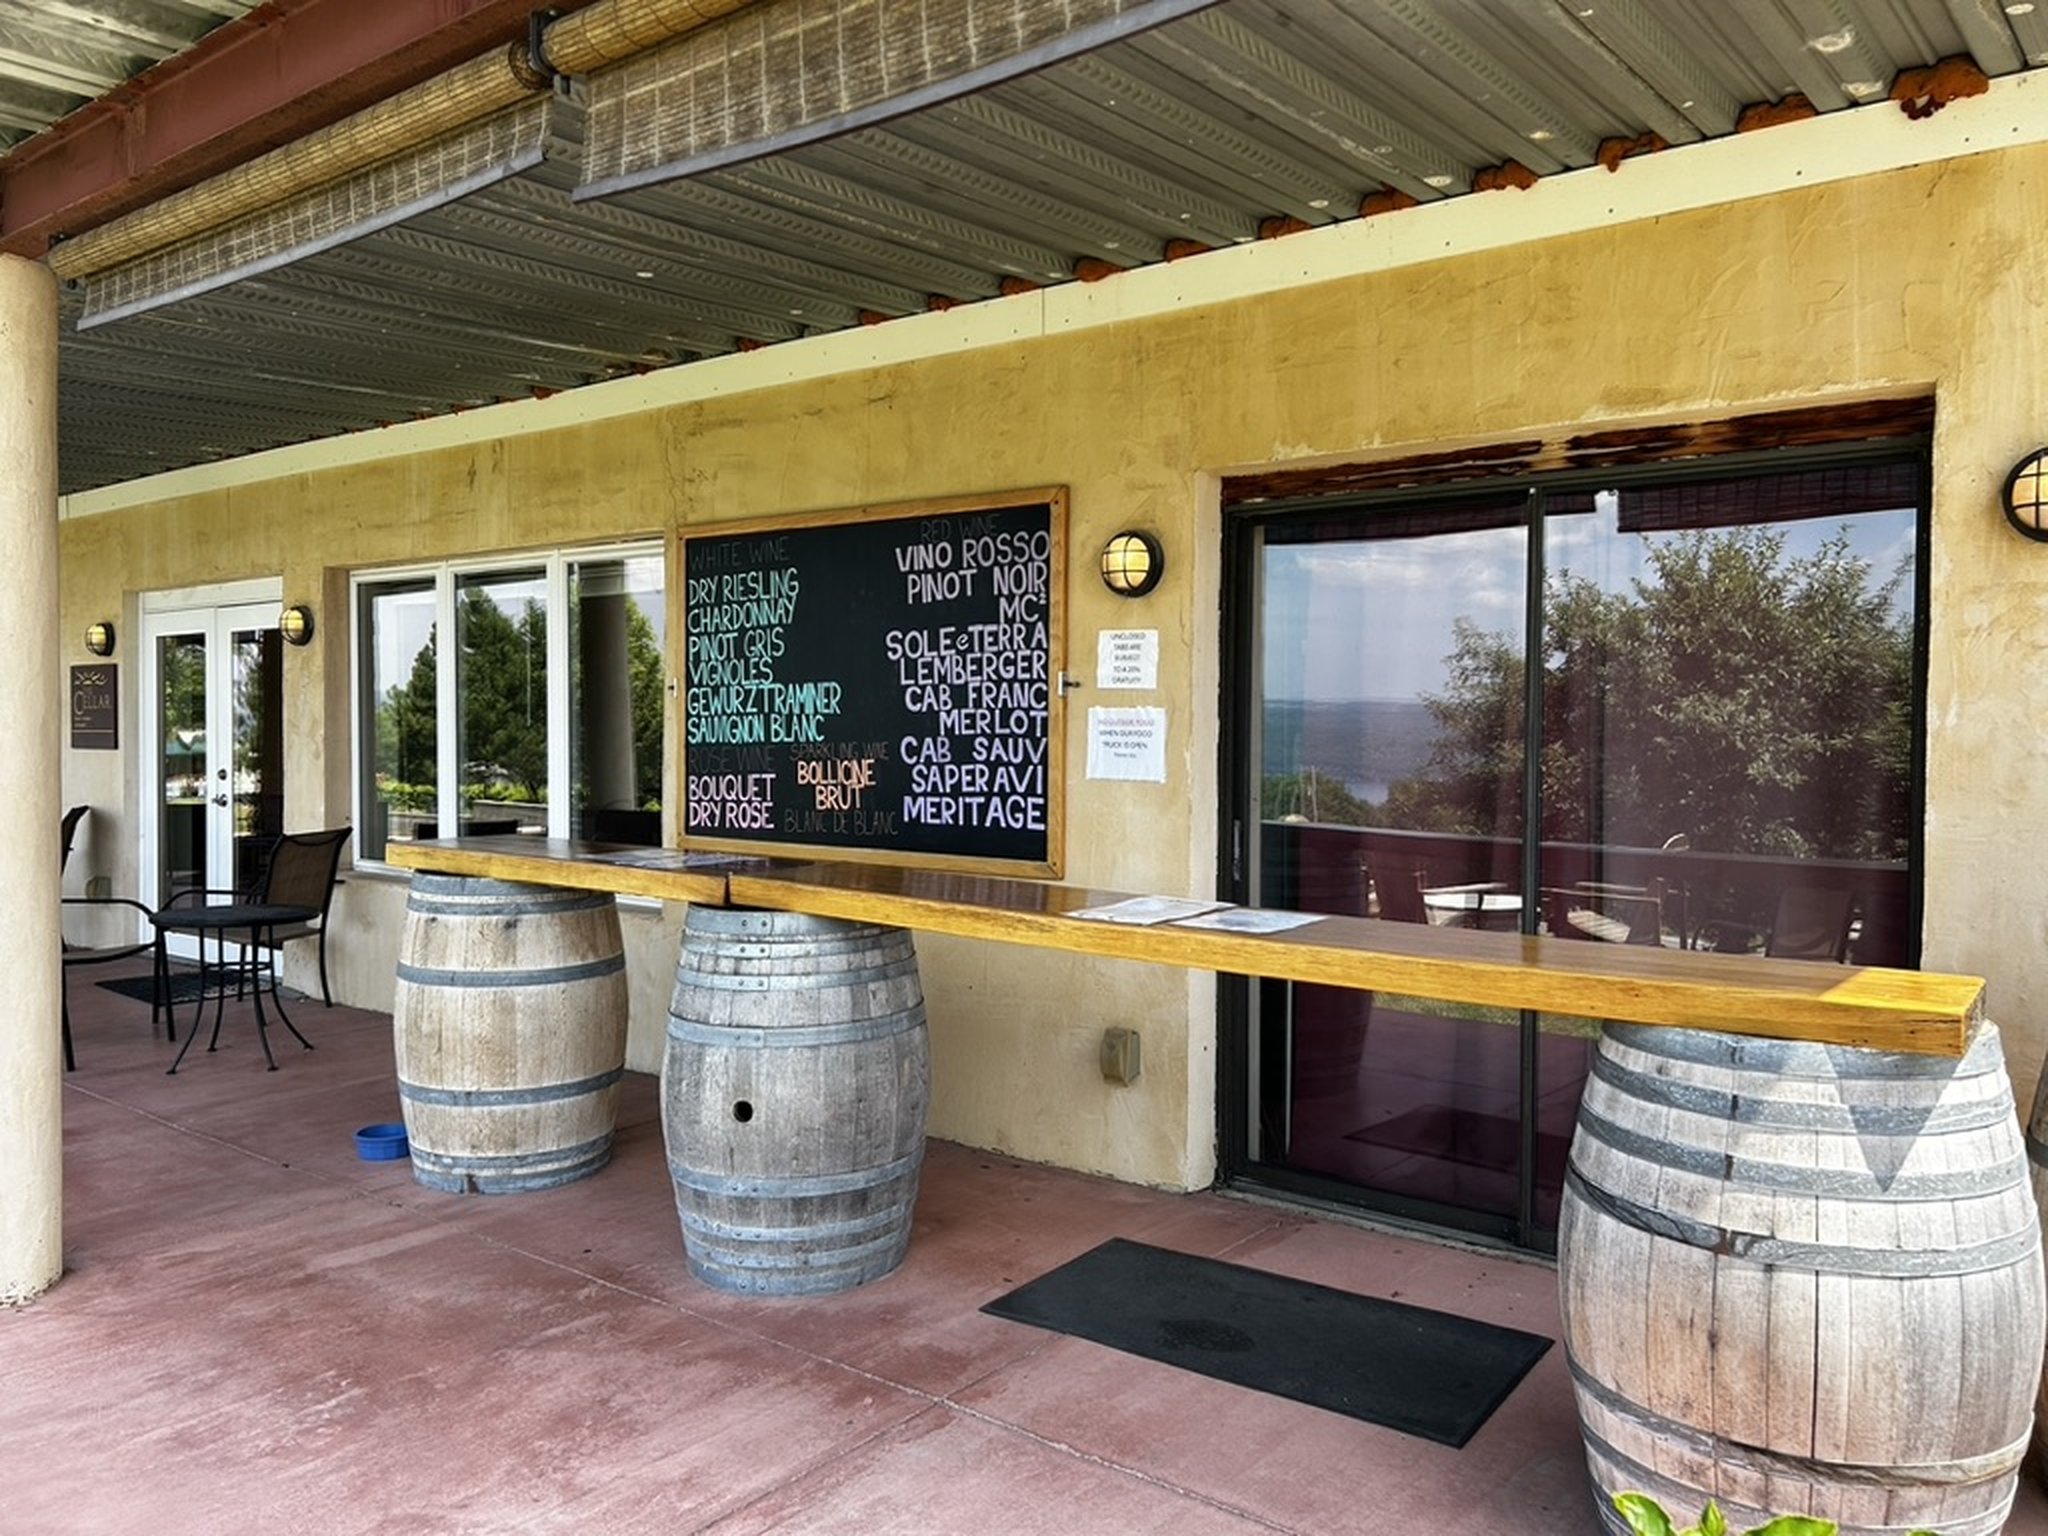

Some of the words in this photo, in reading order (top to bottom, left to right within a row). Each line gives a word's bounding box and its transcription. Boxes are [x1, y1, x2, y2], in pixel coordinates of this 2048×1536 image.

[920, 519, 950, 542] RED
[958, 513, 999, 538] WINE
[692, 542, 742, 571] WHITE
[749, 536, 790, 563] WINE
[895, 541, 951, 572] VINO
[963, 530, 1049, 568] ROSSO
[688, 576, 718, 606] DRY
[723, 567, 799, 602] RIESLING
[908, 568, 977, 604] PINOT
[994, 560, 1047, 595] NOIR
[688, 596, 796, 633] CHARDONNAY
[688, 632, 738, 661] PINOT
[744, 626, 785, 657] GRIS
[886, 627, 955, 660] SOLE
[968, 622, 1047, 652] TERRA
[688, 656, 773, 685] VIGNOLES
[900, 650, 1046, 685] LEMBERGER
[905, 684, 952, 712] CAB
[968, 681, 1047, 709] FRANC
[687, 715, 765, 744] SAUVIGNON
[770, 713, 824, 743] BLANC
[939, 708, 1047, 737] MERLOT
[736, 746, 775, 771] WINE
[790, 742, 859, 760] SPARKLING
[862, 741, 889, 760] WINE
[900, 735, 950, 764] CAB
[972, 736, 1046, 764] SAUV
[690, 773, 776, 801] BOUQUET
[911, 763, 1044, 794] SAPERAVI
[815, 785, 861, 810] BRUT
[903, 794, 1045, 830] MERITAGE
[689, 802, 721, 827] DRY
[725, 802, 775, 828] ROSE
[784, 809, 827, 833] BLANC
[833, 810, 849, 834] DE
[854, 810, 898, 836] BLANC
